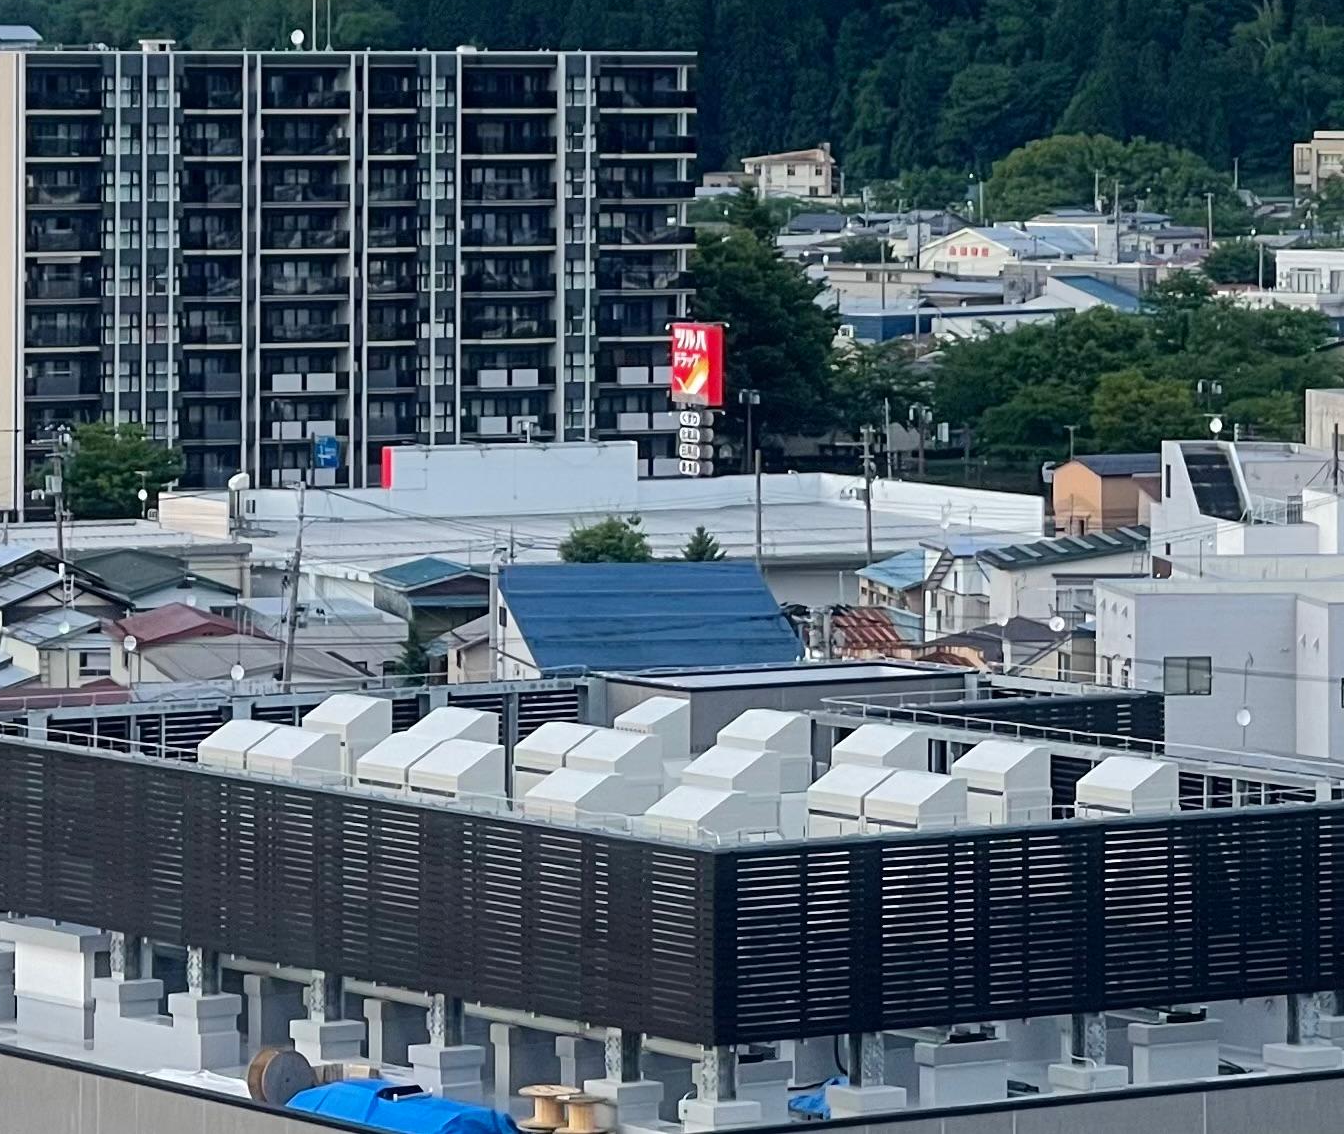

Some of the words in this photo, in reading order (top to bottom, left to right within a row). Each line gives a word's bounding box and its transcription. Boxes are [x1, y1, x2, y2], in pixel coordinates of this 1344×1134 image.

[674, 329, 707, 351] ツルハ
[674, 351, 702, 368] ドラッグ
[682, 413, 698, 425] くすり
